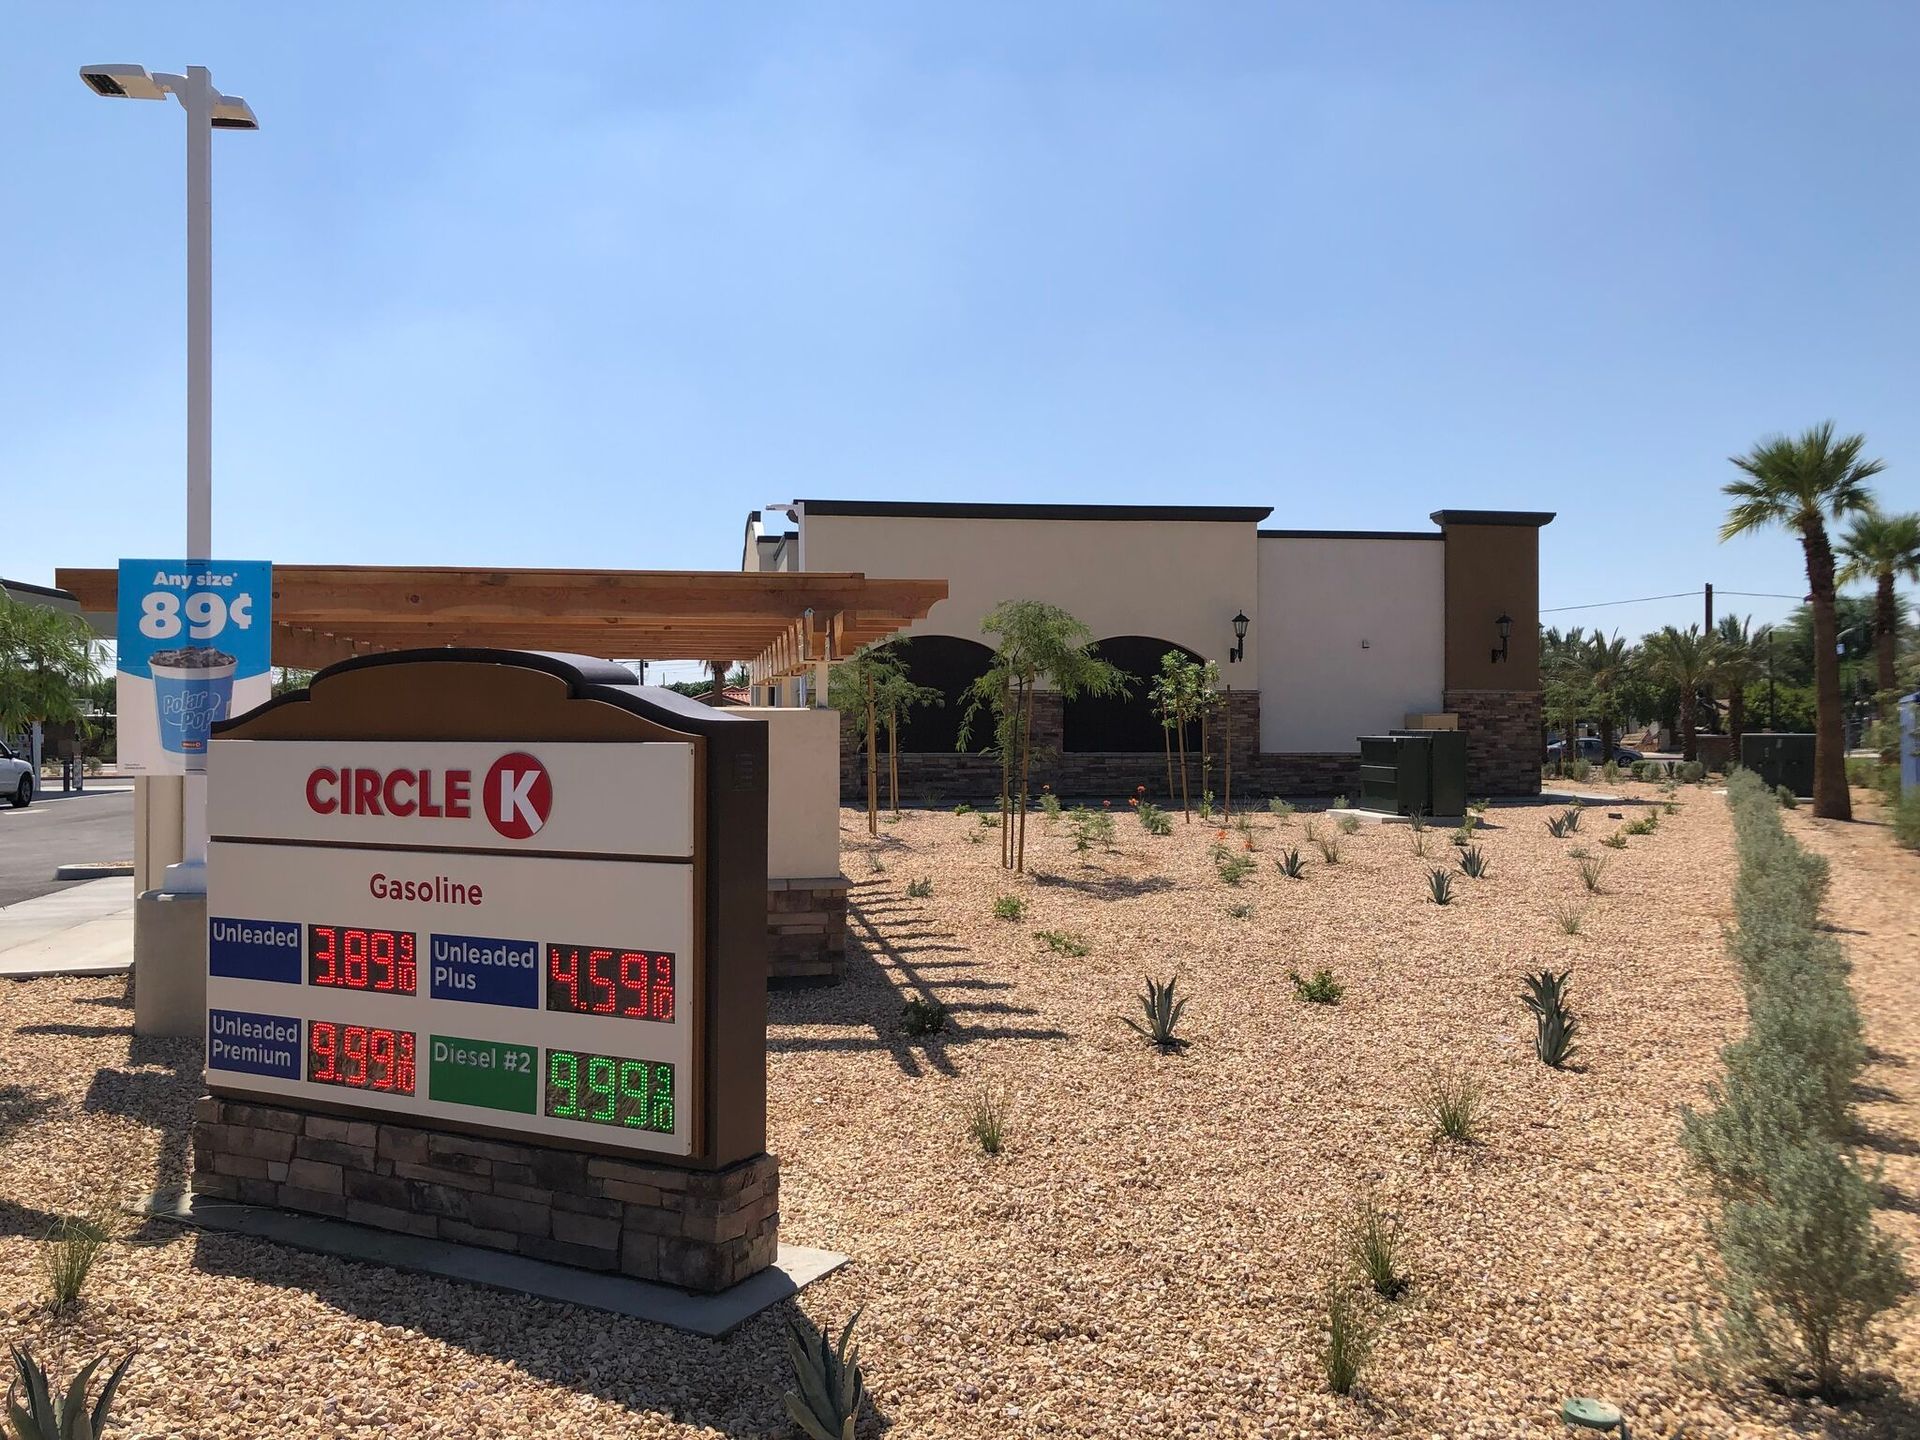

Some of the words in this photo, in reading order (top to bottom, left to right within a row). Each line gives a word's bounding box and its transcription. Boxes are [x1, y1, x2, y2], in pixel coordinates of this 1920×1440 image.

[153, 571, 192, 590] Any
[139, 591, 252, 639] 89¢
[163, 690, 208, 715] Polar
[306, 766, 471, 818] CIRCLE
[500, 769, 544, 834] K
[369, 873, 483, 906] Gasoline
[213, 922, 298, 948] Unleaded
[434, 940, 535, 969] Unleaded
[434, 967, 477, 990] Plus
[212, 1015, 298, 1043] Unleaded
[212, 1039, 291, 1067] Premium
[434, 1041, 496, 1069] Diesel
[503, 1050, 531, 1074] #2
